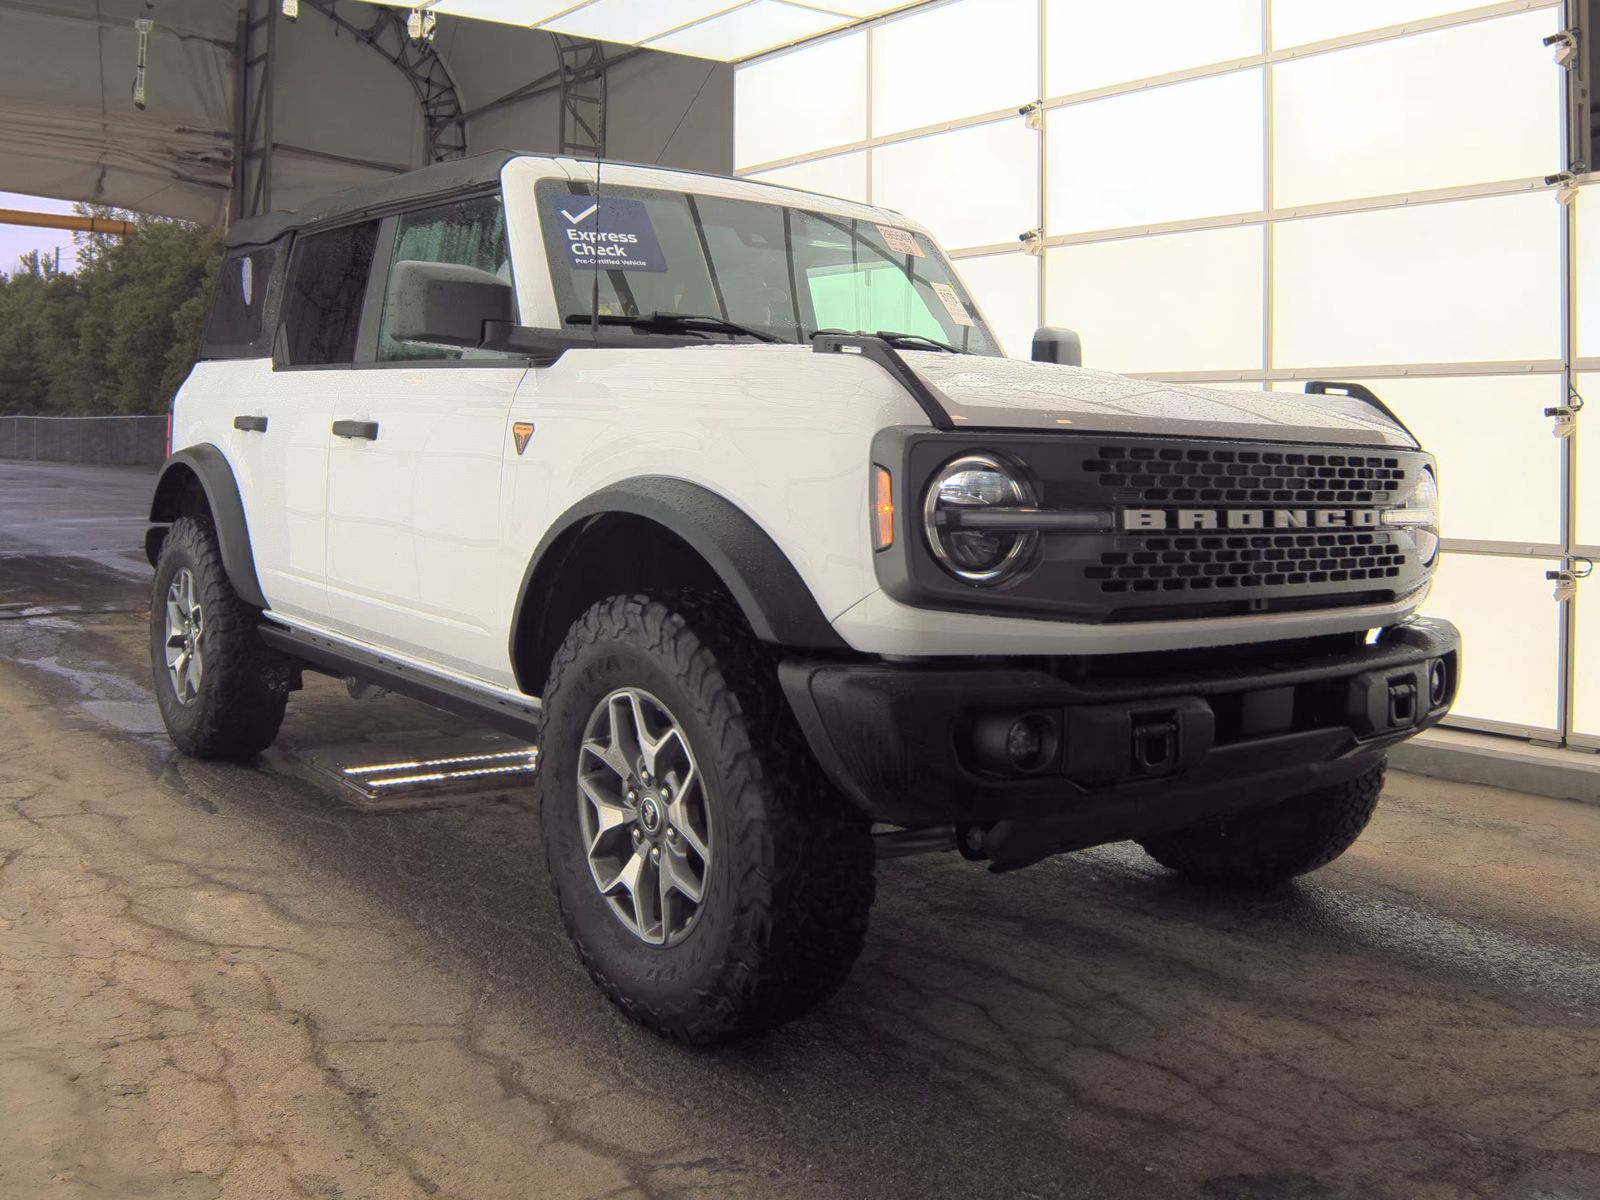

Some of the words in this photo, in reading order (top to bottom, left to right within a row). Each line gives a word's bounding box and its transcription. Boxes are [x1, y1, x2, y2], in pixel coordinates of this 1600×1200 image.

[566, 229, 638, 243] Express
[571, 244, 627, 257] Check
[1123, 509, 1380, 530] BRONCO
